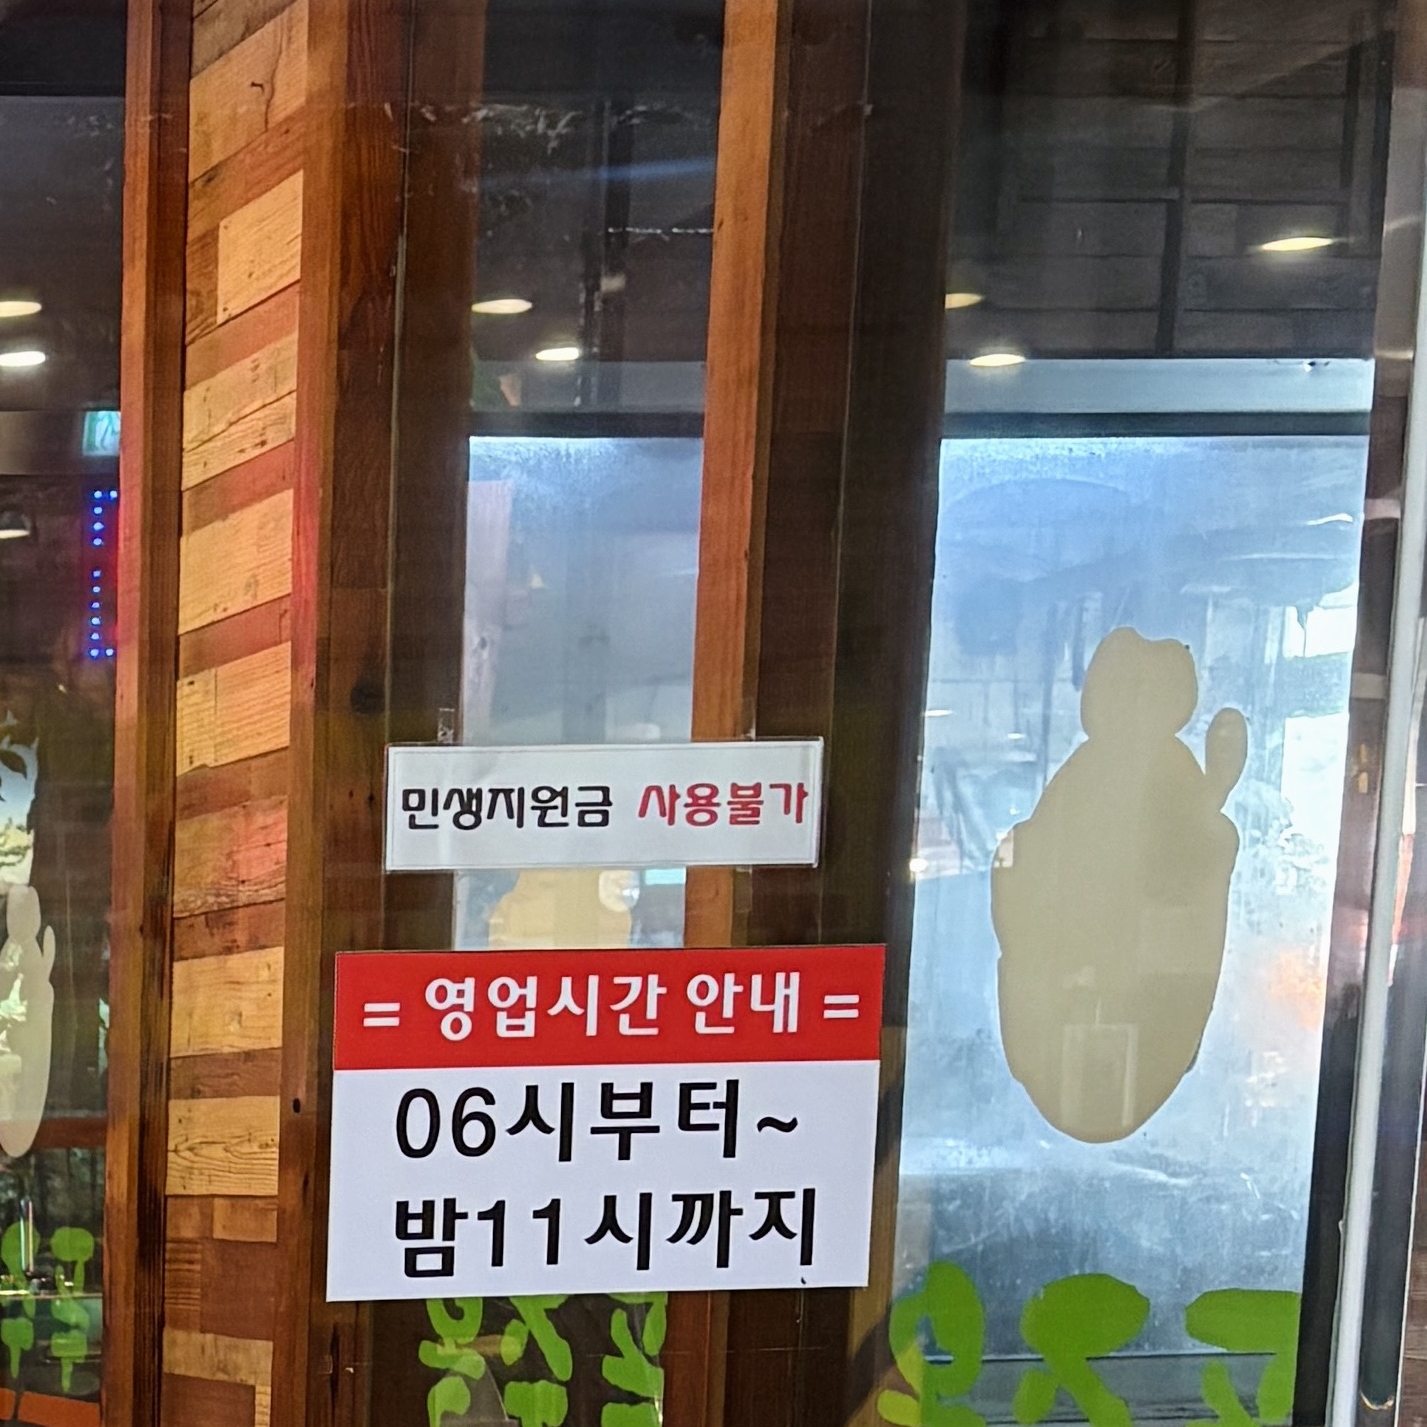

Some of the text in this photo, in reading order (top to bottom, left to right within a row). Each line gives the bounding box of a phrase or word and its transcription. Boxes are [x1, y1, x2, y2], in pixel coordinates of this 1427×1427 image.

[401, 782, 810, 832] 민생지원금 사용불가
[424, 970, 802, 1041] 영업시간 안내
[393, 1077, 800, 1163] 06시부터~
[393, 1187, 818, 1280] 밤11시까지
